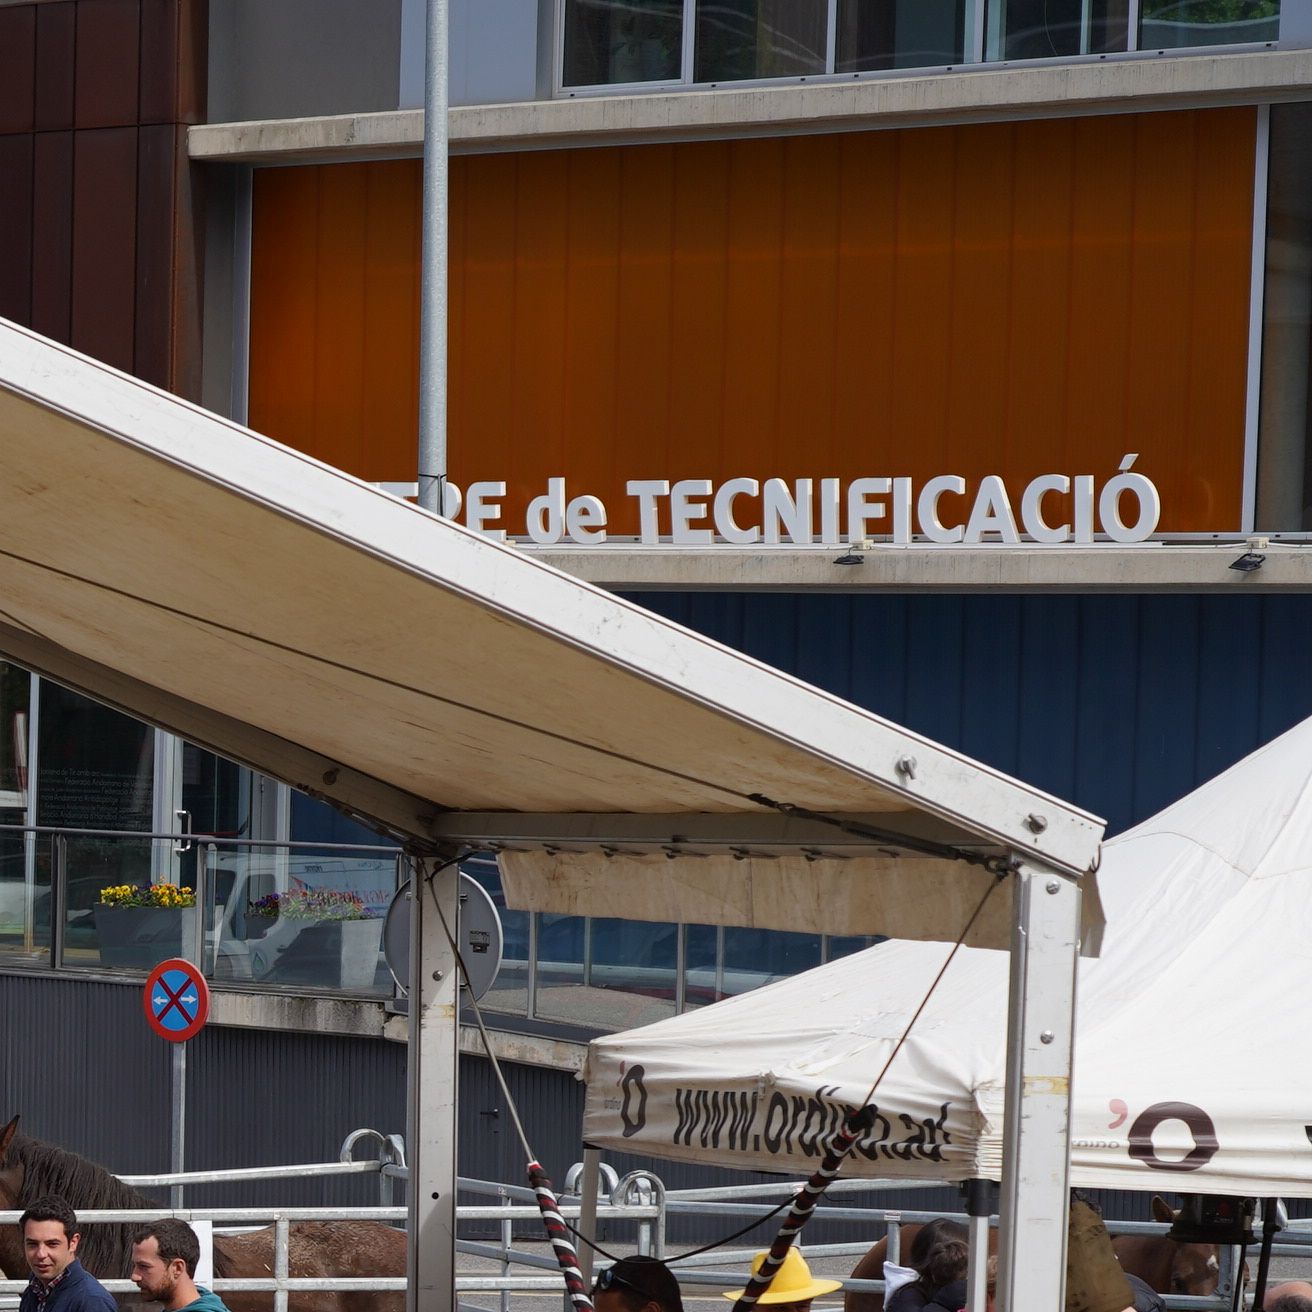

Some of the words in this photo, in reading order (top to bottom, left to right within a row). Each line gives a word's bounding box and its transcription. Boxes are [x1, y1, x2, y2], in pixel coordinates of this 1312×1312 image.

[527, 477, 609, 544] de
[626, 453, 1161, 545] TECNIFICACIÓ
[674, 1085, 951, 1162] www.ordio.ad
